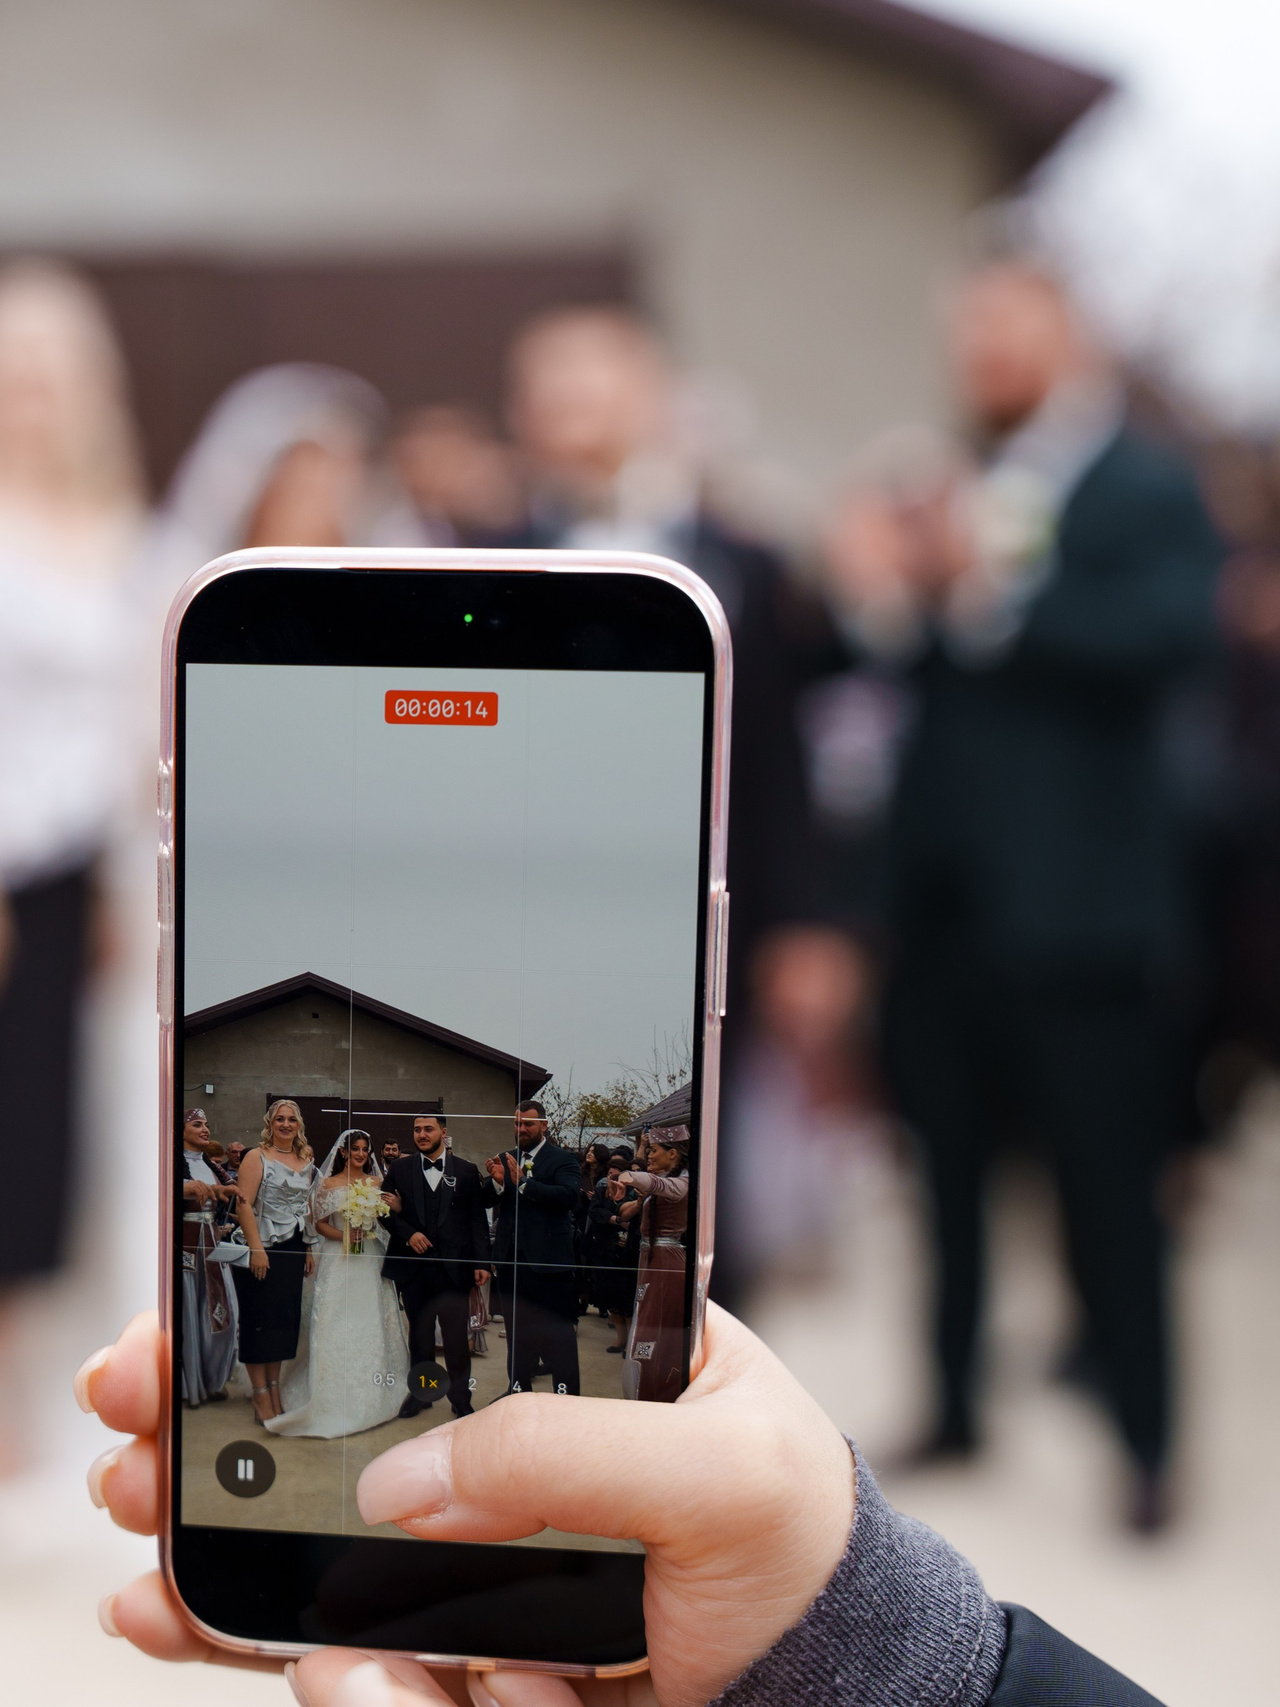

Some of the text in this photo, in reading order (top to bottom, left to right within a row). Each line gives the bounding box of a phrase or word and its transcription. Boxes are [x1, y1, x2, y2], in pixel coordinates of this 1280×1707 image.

[394, 698, 489, 719] 00:00:14
[468, 1378, 477, 1391] 2
[512, 1380, 522, 1393] 4
[557, 1383, 567, 1395] 8
